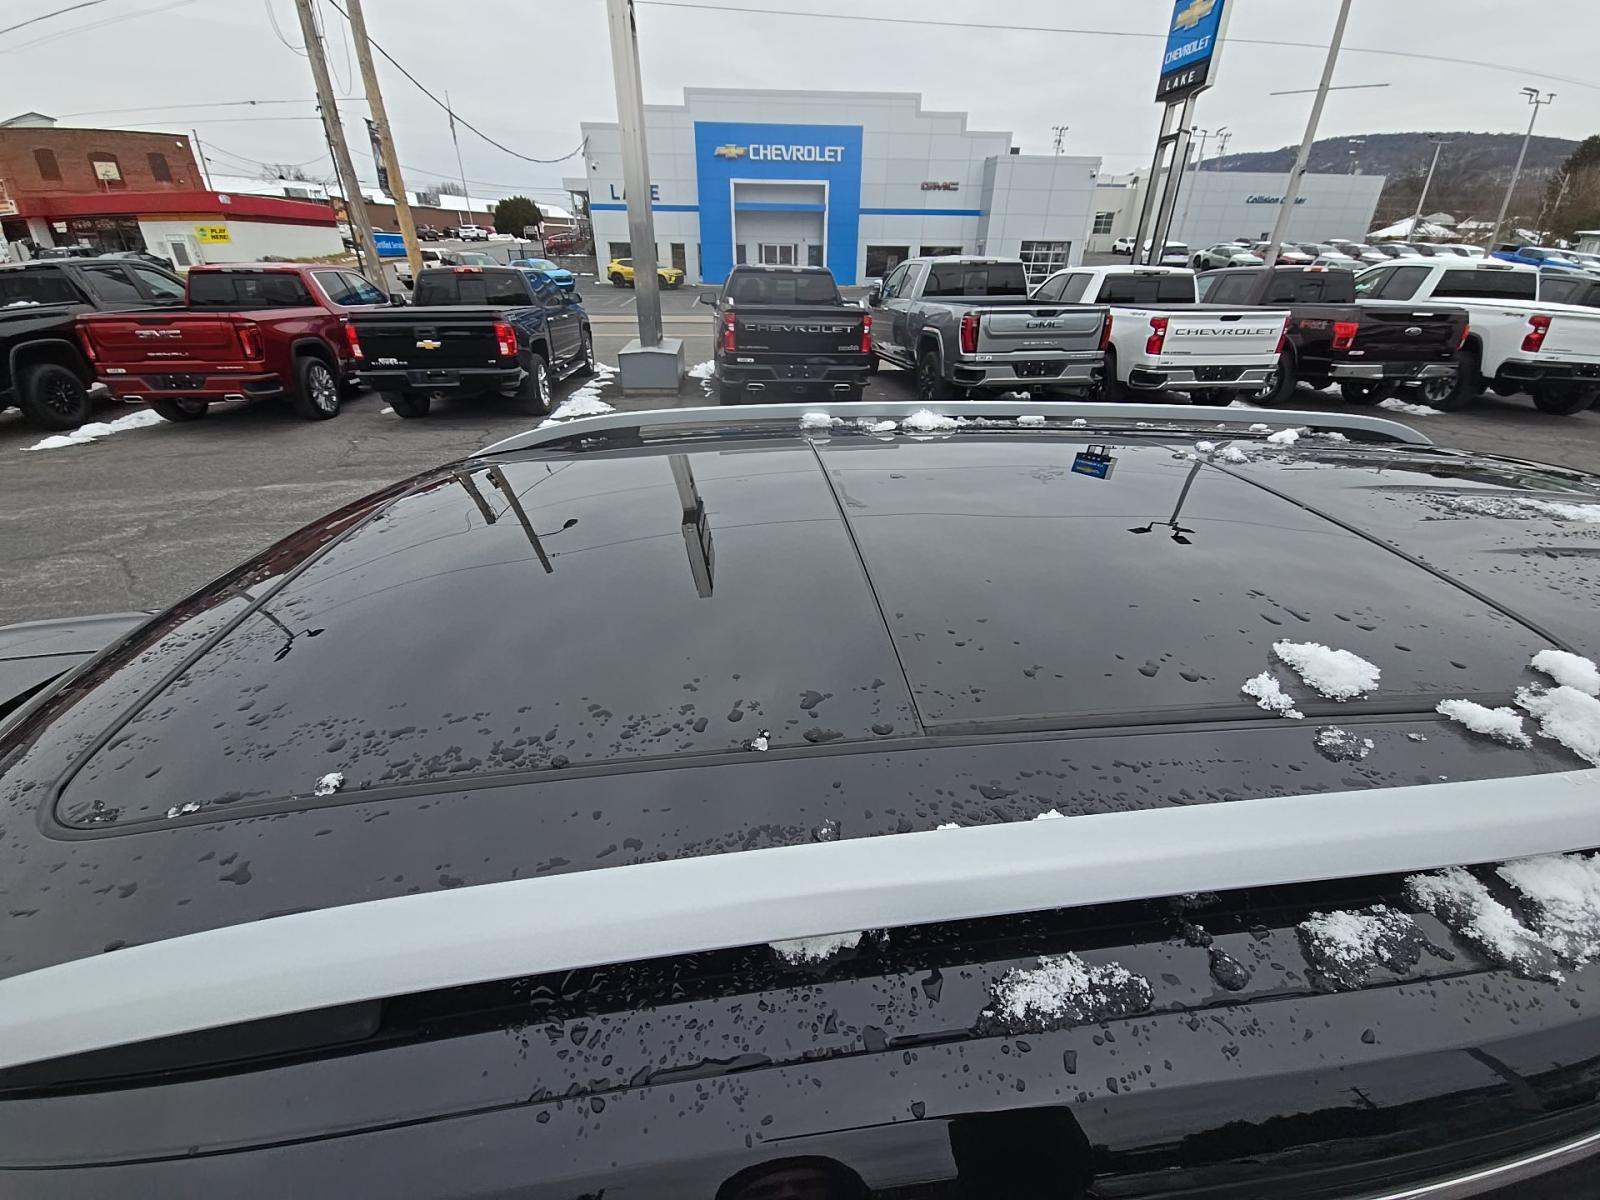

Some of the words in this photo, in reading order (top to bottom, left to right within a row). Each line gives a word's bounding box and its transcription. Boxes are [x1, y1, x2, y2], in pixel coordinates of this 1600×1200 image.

[1164, 35, 1212, 65] CHEVROLET
[1165, 70, 1196, 91] LAKE
[748, 144, 845, 162] CHEVROLET
[920, 181, 959, 191] GMC
[610, 183, 660, 201] LE
[1246, 195, 1280, 205] Collision
[744, 324, 855, 334] CHEVROLET
[1026, 319, 1065, 329] GMC
[1175, 328, 1277, 336] CHEVROLET
